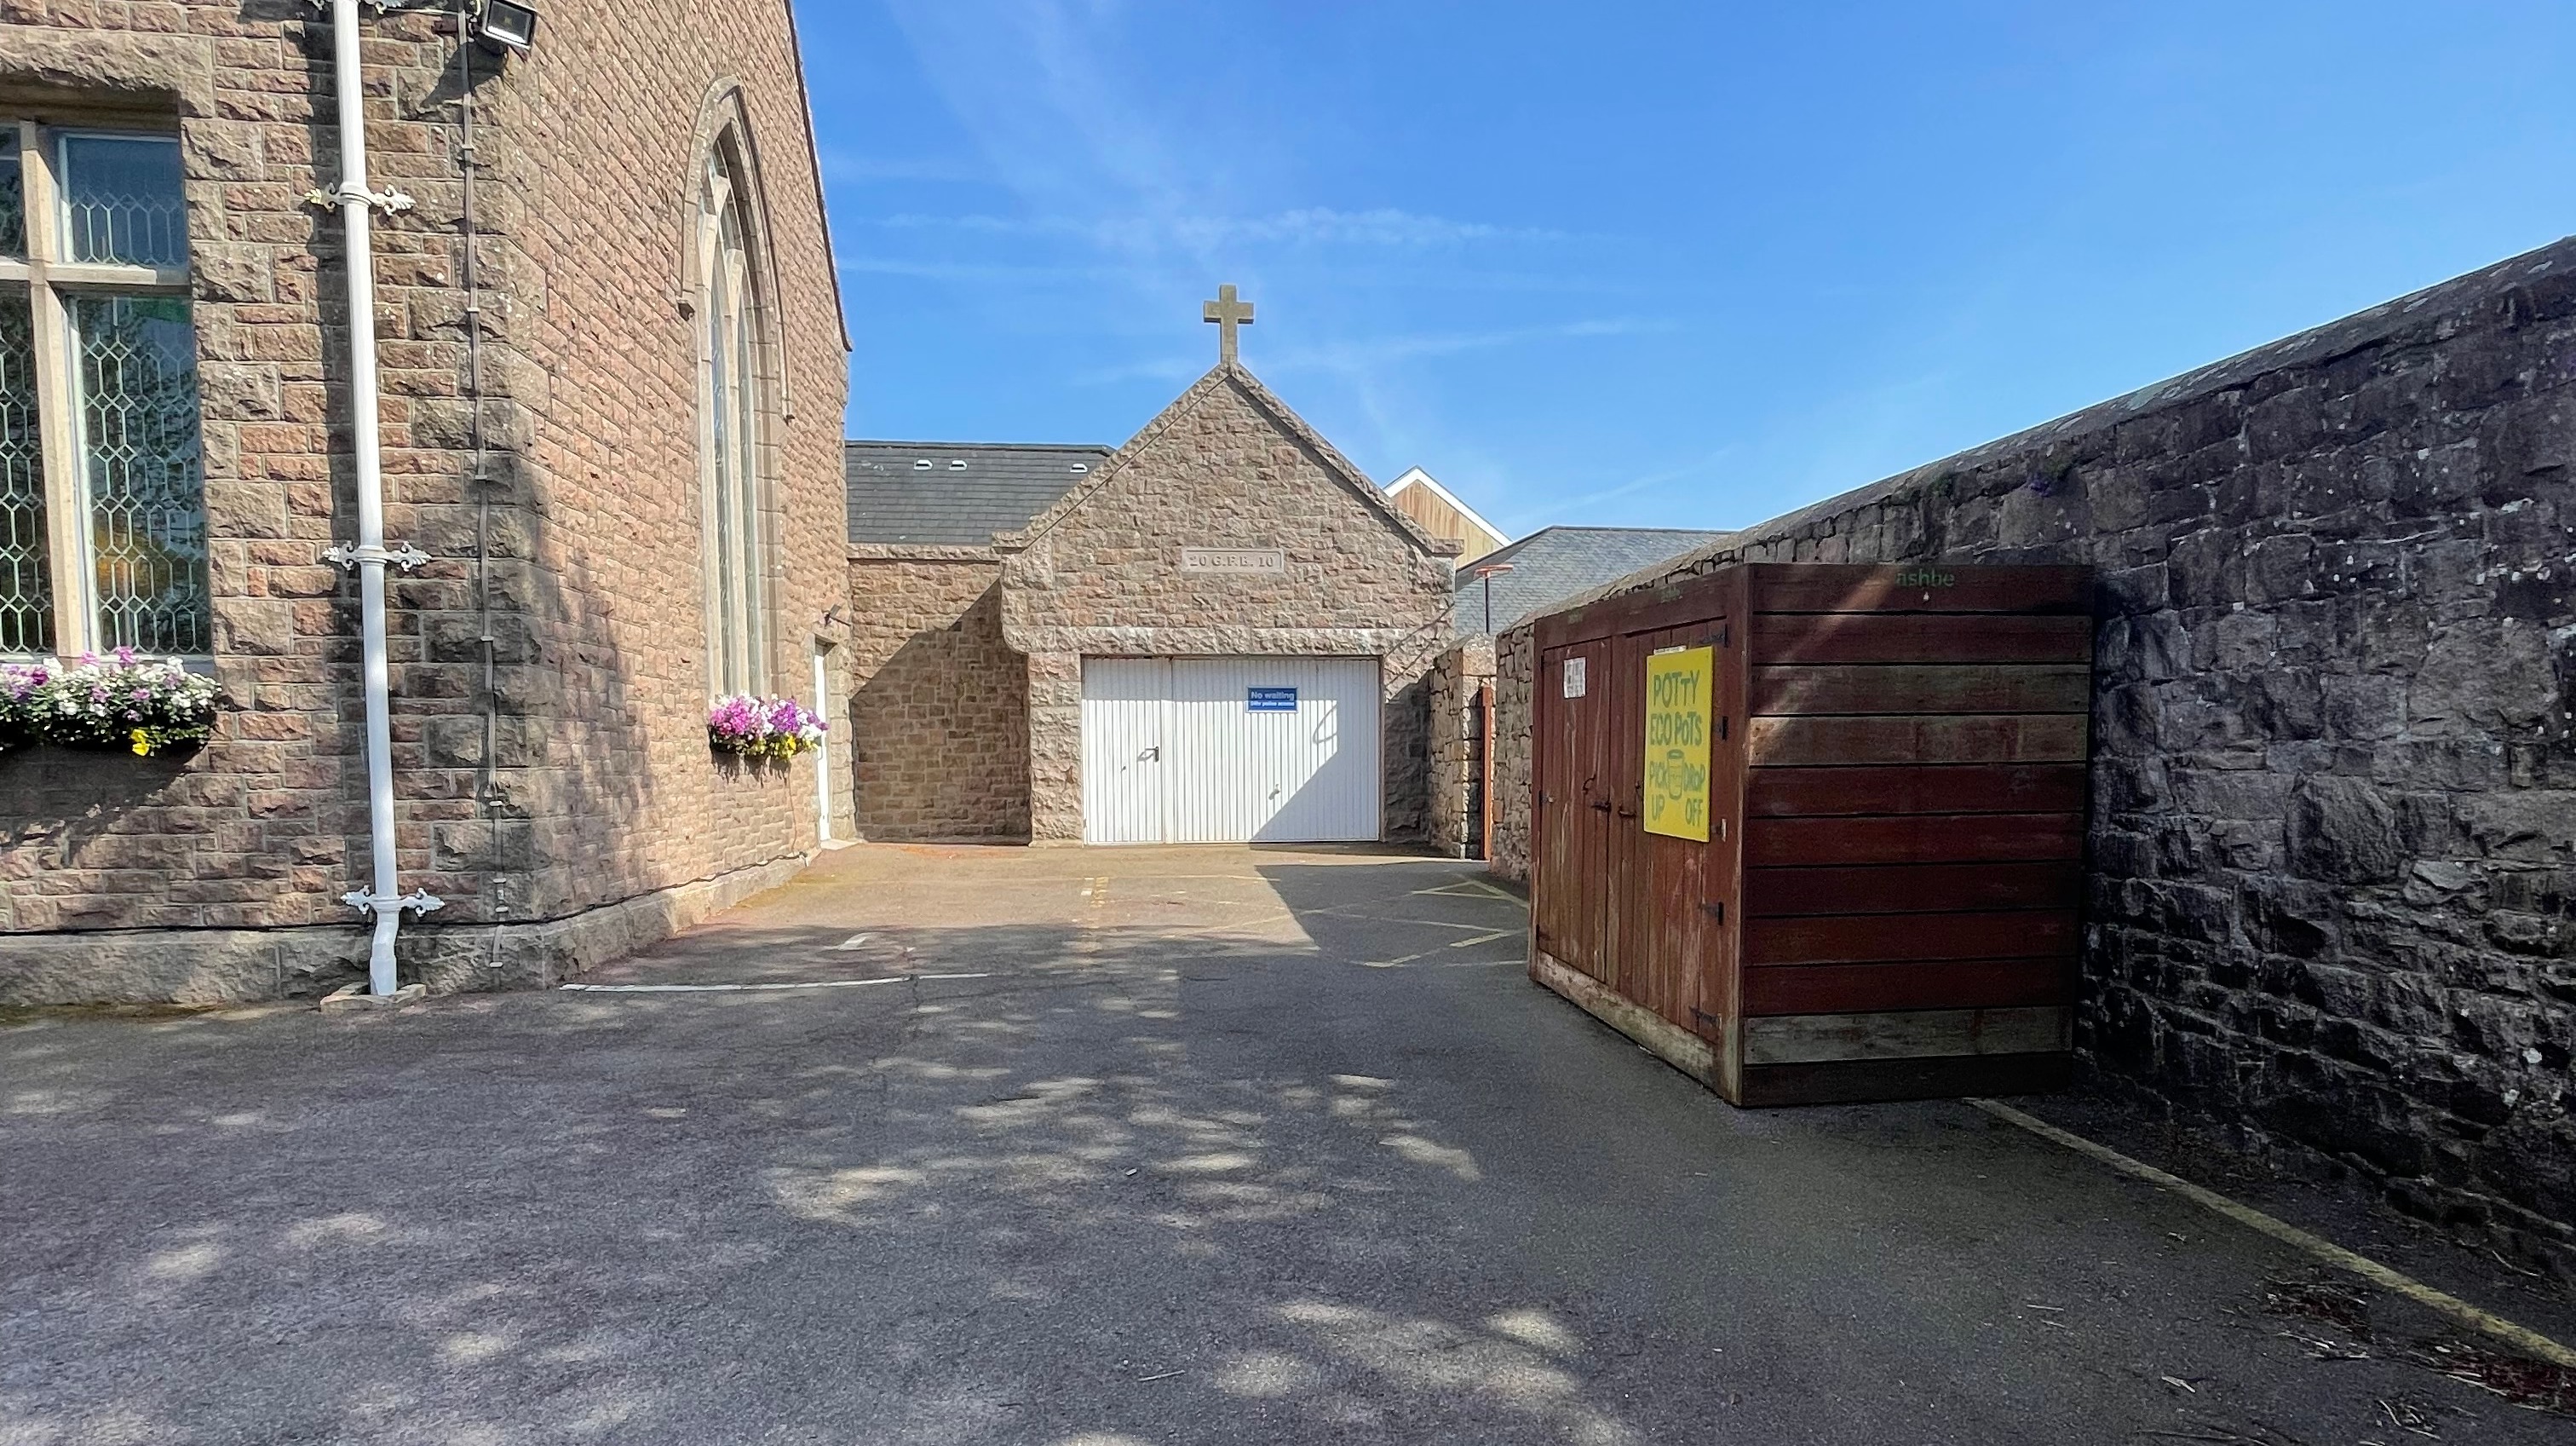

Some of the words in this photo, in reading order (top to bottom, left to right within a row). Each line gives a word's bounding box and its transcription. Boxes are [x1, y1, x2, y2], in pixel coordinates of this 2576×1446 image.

[1188, 556, 1207, 567] 20
[1258, 556, 1274, 567] 10
[1264, 691, 1295, 701] waiting
[1653, 669, 1701, 708] POTTY
[1649, 712, 1672, 746] ECO
[1648, 761, 1668, 789] PICK
[1683, 762, 1706, 792] DROP
[1651, 793, 1665, 821] UP
[1685, 798, 1704, 827] OFF
